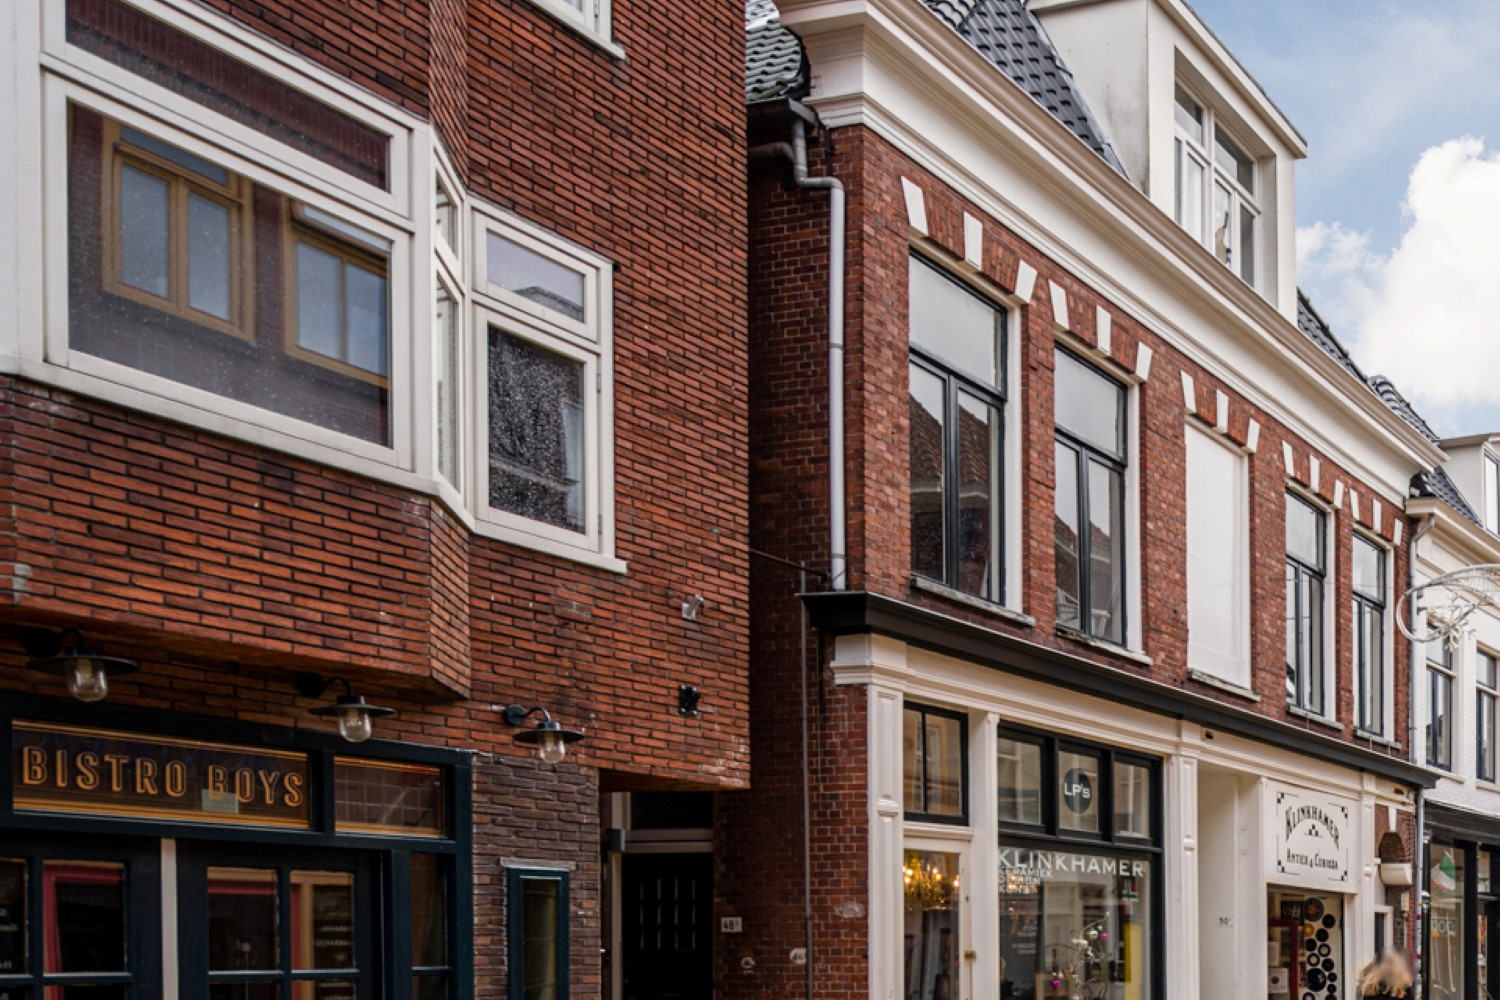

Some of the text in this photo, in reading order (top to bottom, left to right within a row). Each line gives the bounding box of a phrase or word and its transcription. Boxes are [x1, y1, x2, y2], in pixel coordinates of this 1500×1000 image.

[23, 745, 304, 807] BISTRO BOYS
[1285, 805, 1340, 851] KLINKHAMER
[999, 848, 1144, 878] KLINKHAMER
